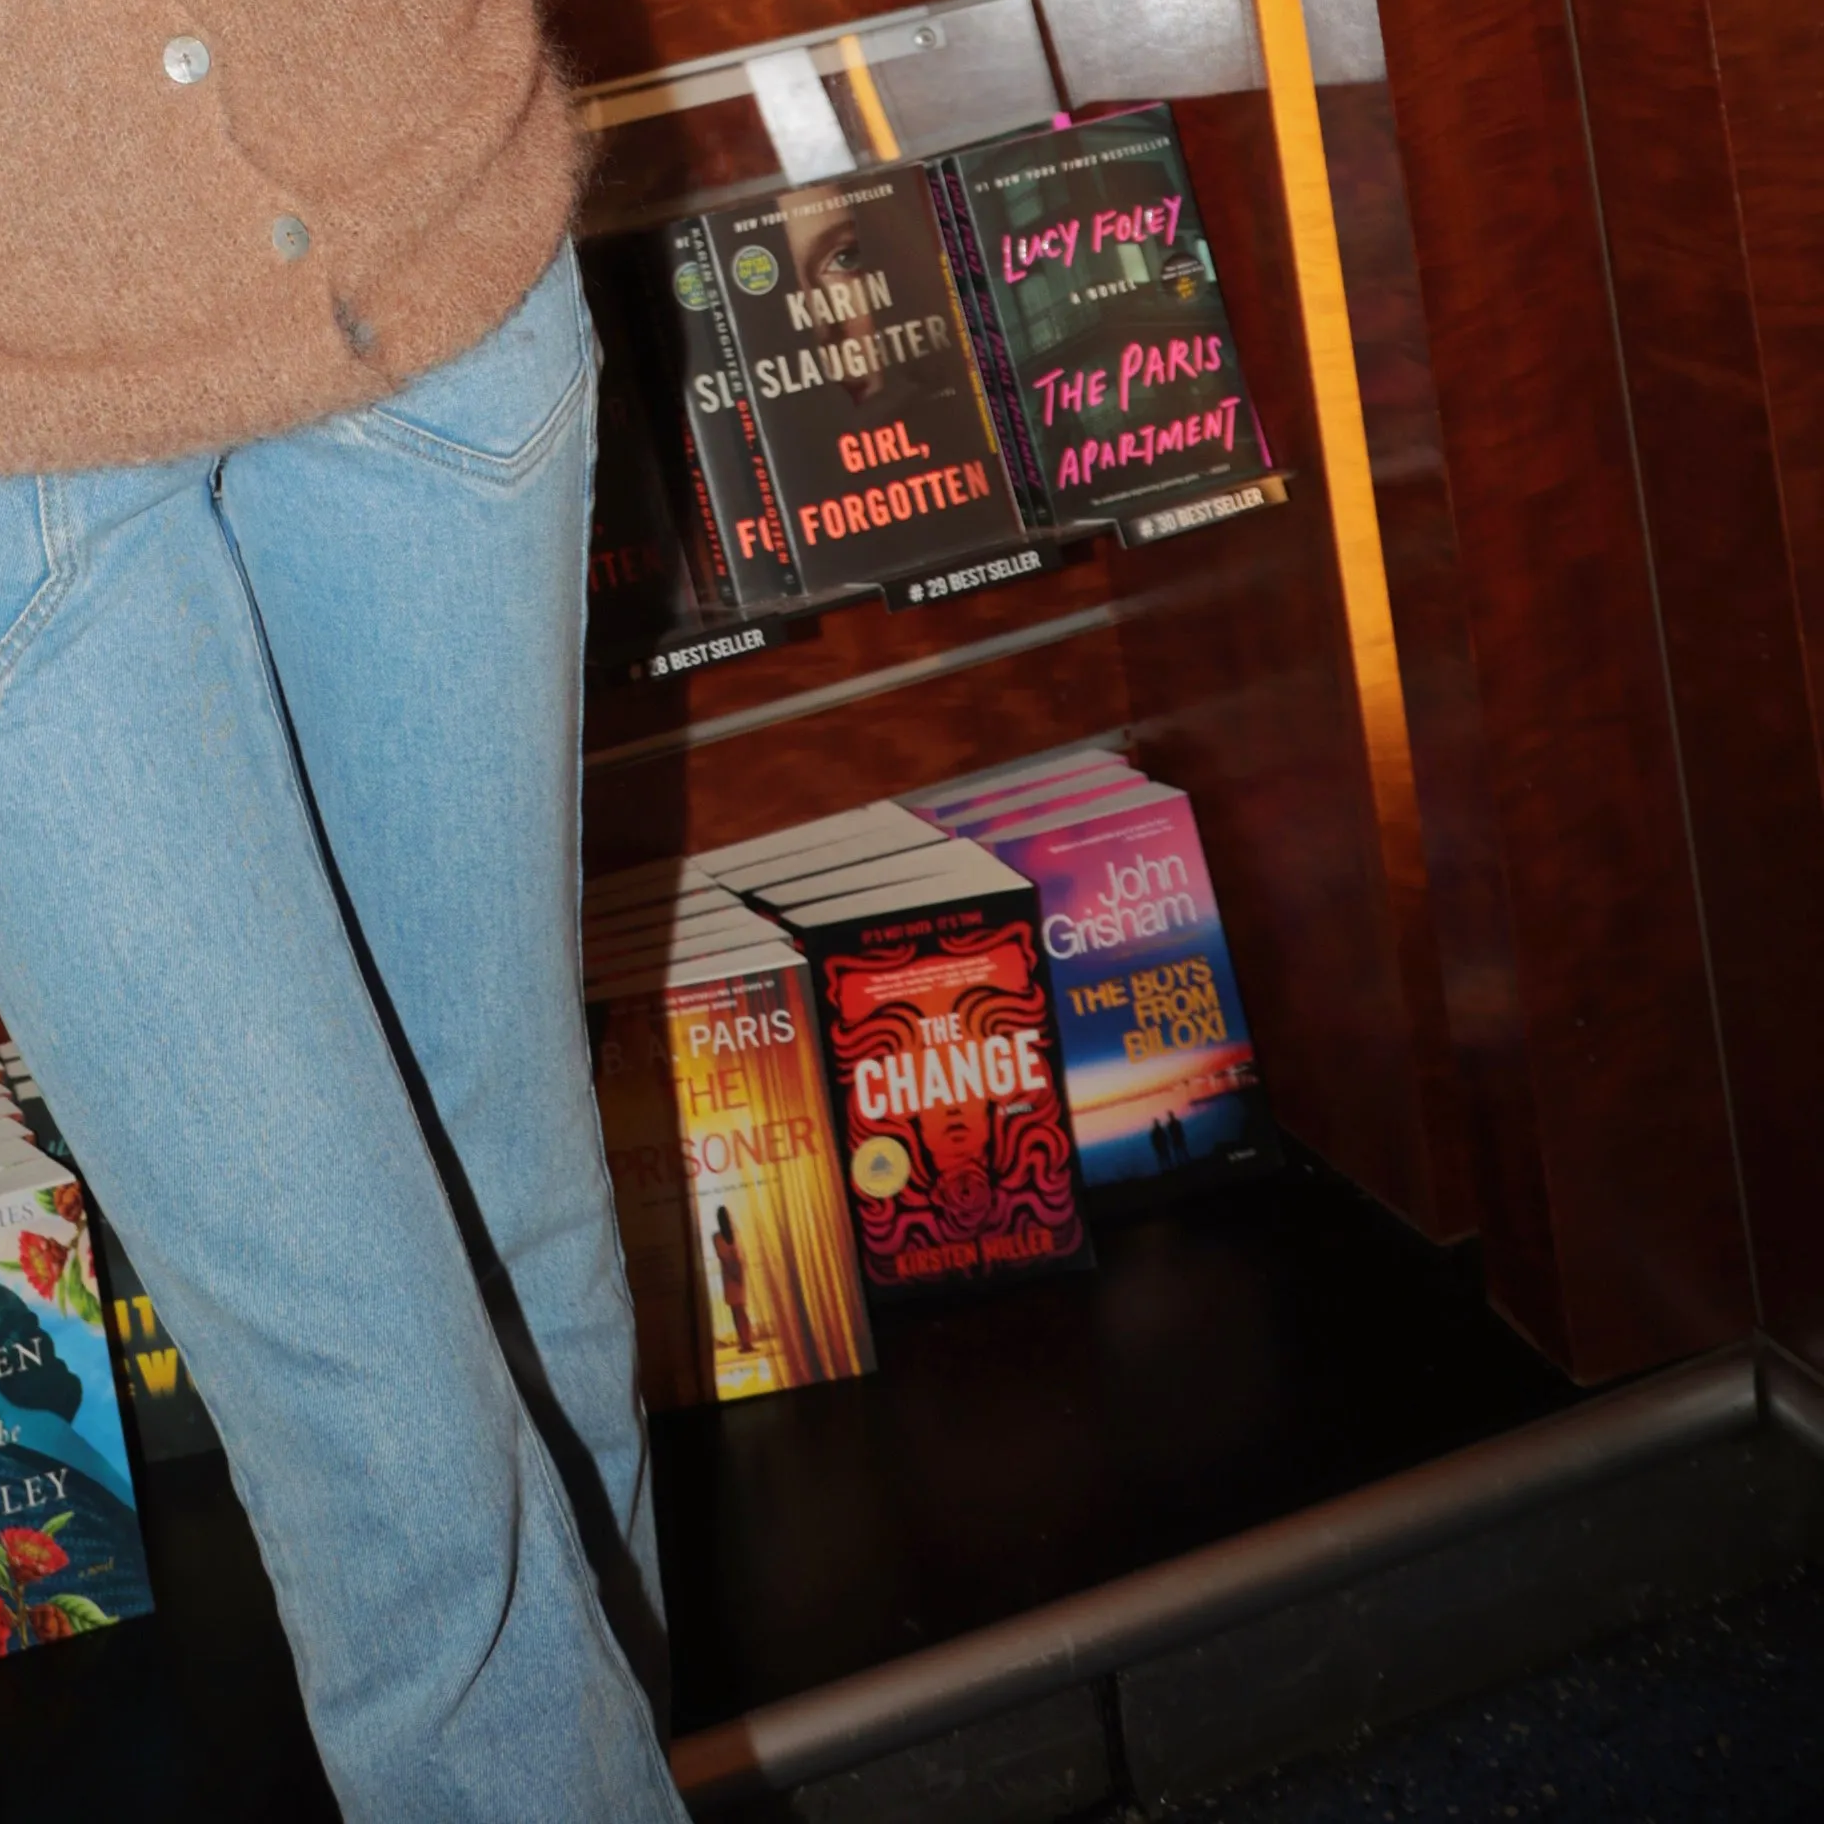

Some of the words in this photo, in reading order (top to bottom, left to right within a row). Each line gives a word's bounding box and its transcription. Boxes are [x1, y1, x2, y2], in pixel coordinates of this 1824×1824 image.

[1001, 222, 1079, 284] LUCY
[1094, 195, 1183, 256] FOLEY
[786, 271, 894, 330] KARIN
[756, 315, 954, 398] SLAUGHTER
[1032, 366, 1106, 427] THE
[1117, 334, 1222, 412] PARIS
[838, 422, 930, 474] GIRL,
[1057, 397, 1242, 490] APARTMENT
[798, 462, 990, 546] FORGOTTEN
[1097, 853, 1188, 907] John
[1042, 894, 1198, 961] Grisham
[918, 1013, 963, 1046] THE
[854, 1031, 1047, 1121] CHANGE
